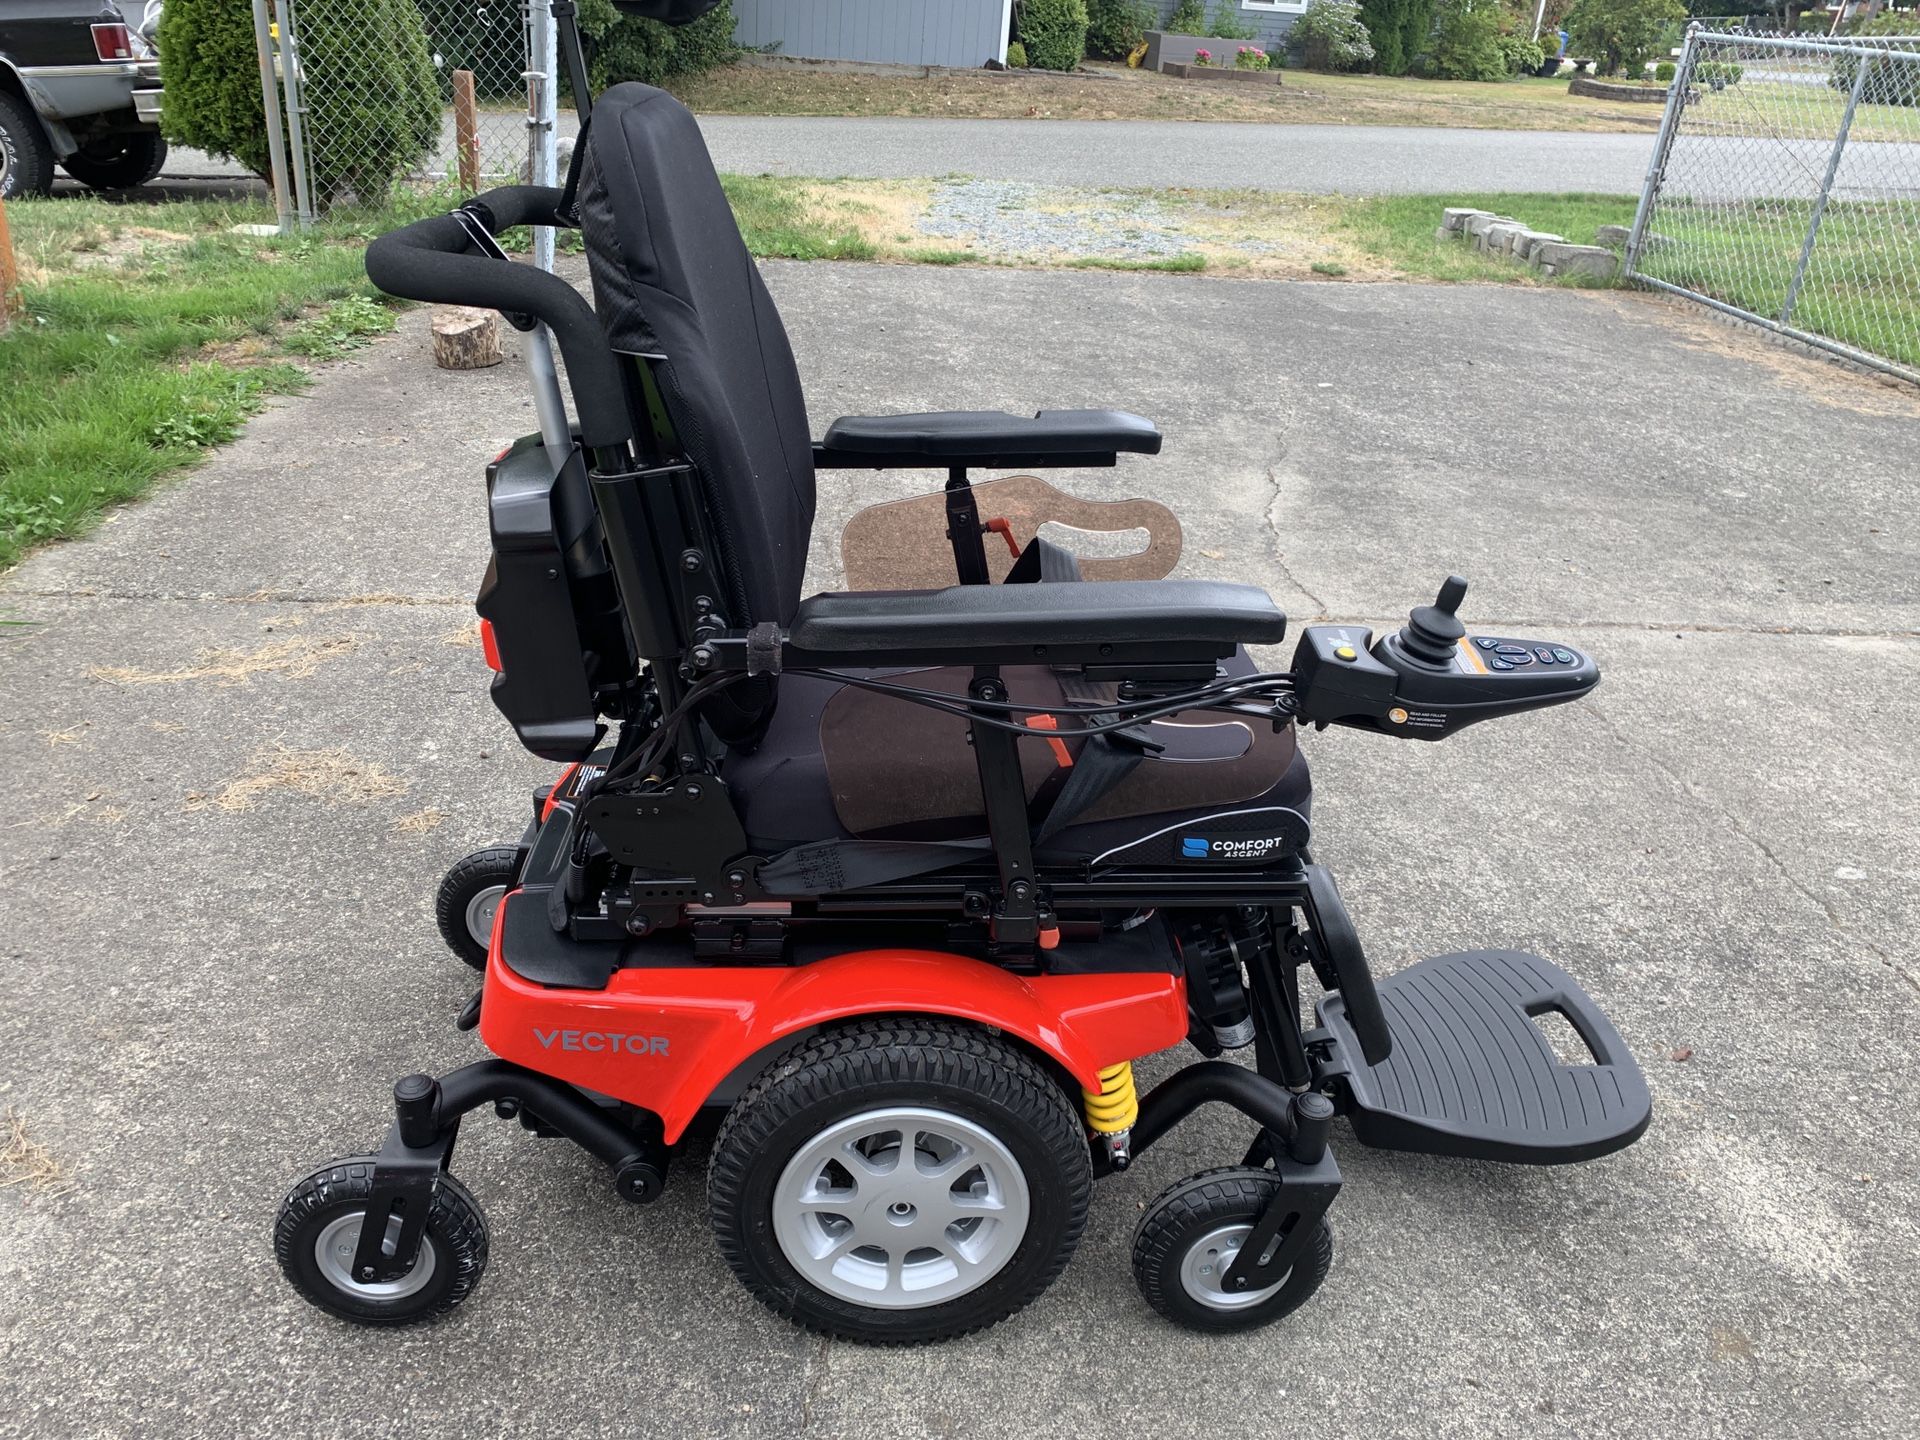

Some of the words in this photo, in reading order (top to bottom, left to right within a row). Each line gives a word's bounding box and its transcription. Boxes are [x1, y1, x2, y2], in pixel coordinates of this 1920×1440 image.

[1212, 837, 1282, 851] COMFORT
[1224, 849, 1268, 858] ASCENT
[532, 1028, 670, 1057] VECTOR
